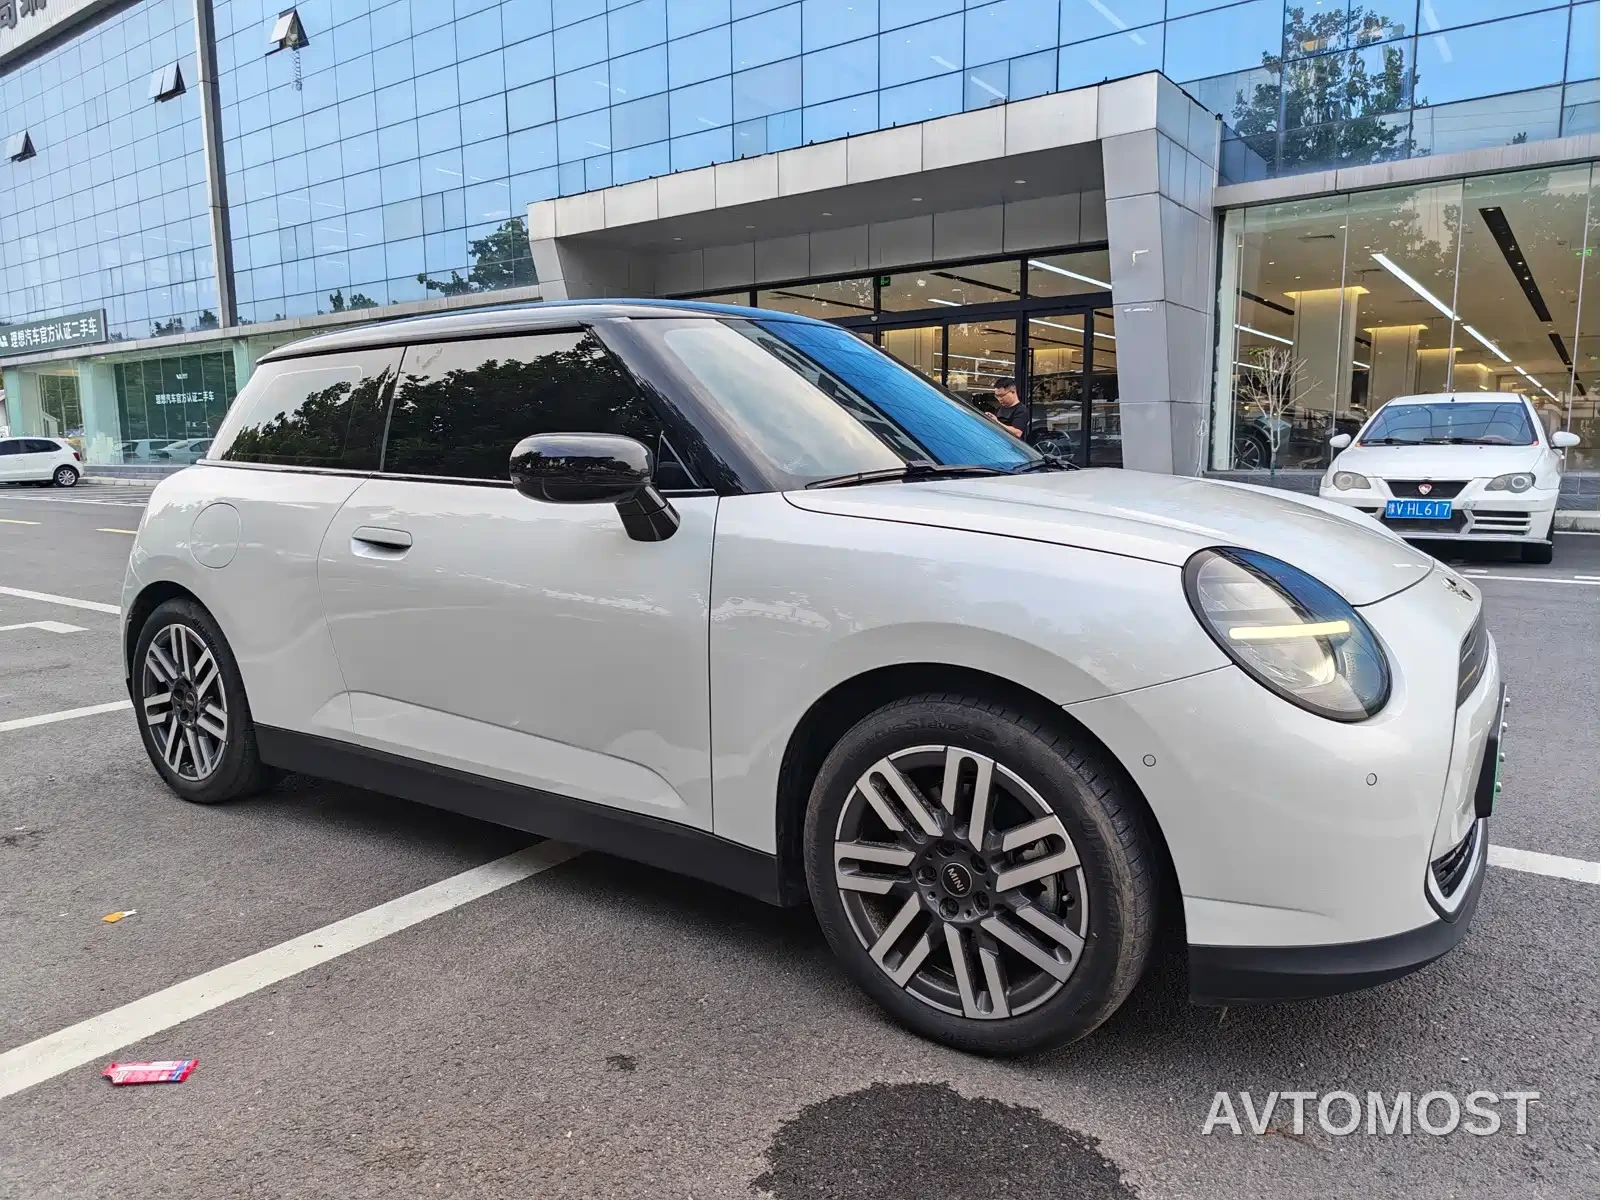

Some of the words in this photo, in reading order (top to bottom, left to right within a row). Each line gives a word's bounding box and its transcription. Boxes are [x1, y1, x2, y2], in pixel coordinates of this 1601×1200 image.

[10, 317, 98, 348] 理想汽车官方认证二手车
[947, 867, 965, 892] MINI
